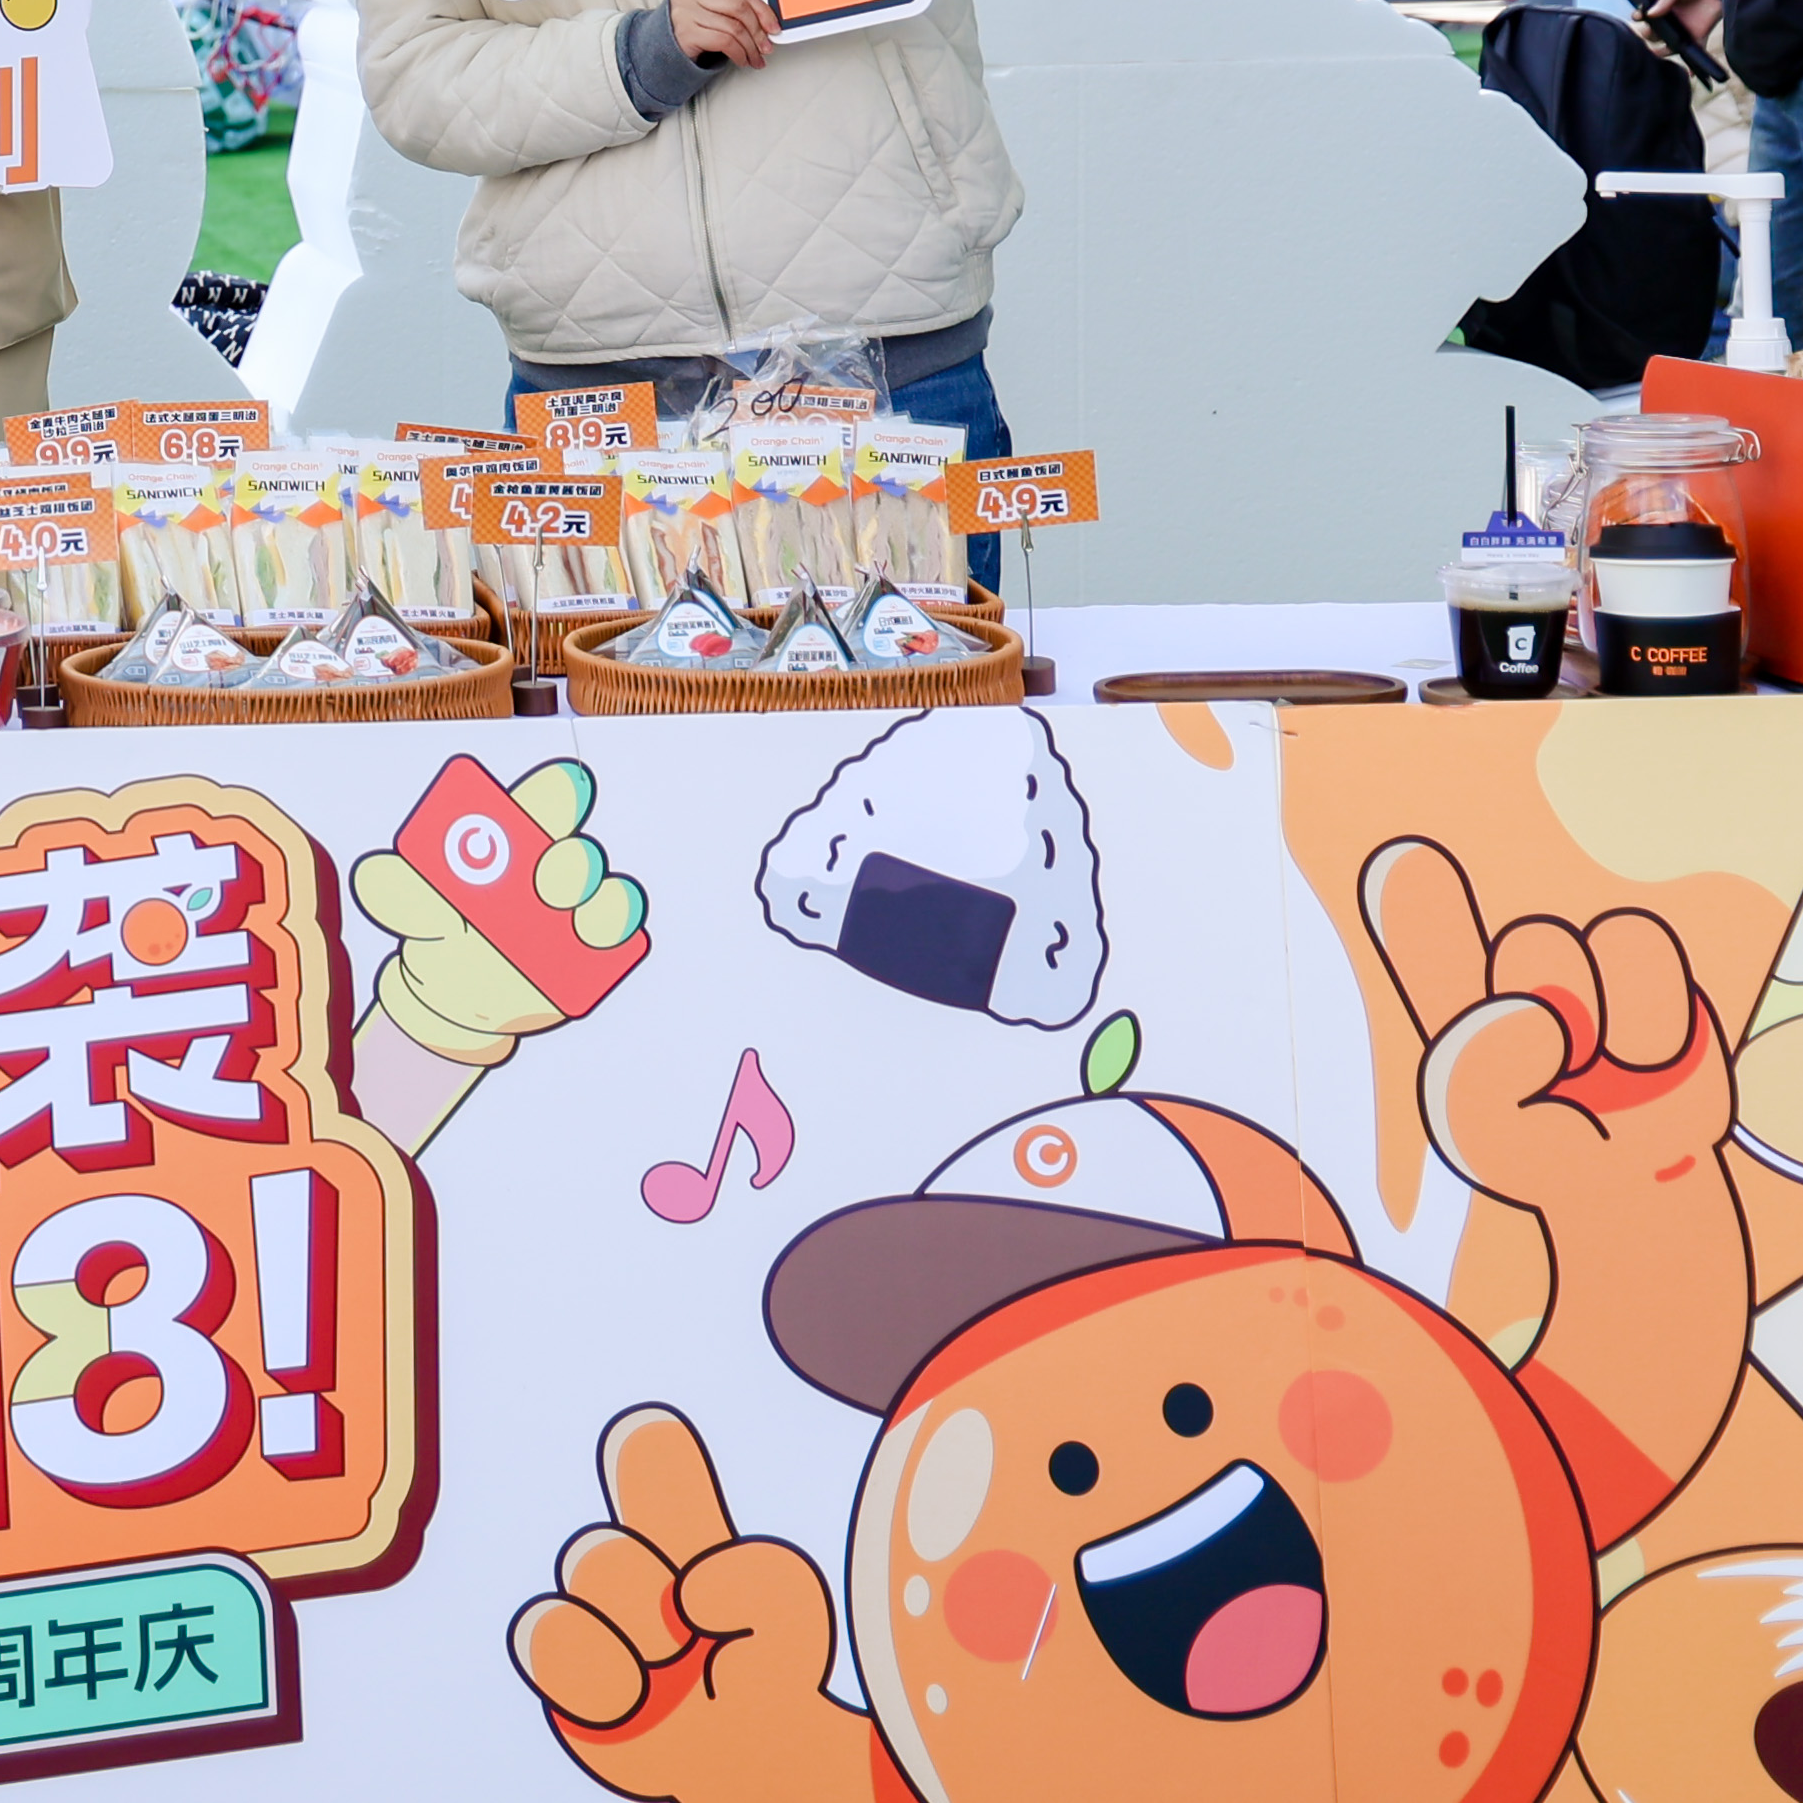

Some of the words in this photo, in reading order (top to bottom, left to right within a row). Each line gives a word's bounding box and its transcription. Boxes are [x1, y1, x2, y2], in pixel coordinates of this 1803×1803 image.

[751, 437, 789, 447] Orange
[874, 433, 911, 445] Orange
[748, 454, 827, 467] SANDWICH
[869, 451, 948, 466] SANDWICH
[252, 461, 287, 472] Orange
[127, 472, 163, 483] Orange
[637, 473, 715, 485] SANDWICH
[247, 479, 326, 493] SANDWICH
[126, 487, 204, 500] SANDWICH
[978, 483, 1067, 523] 4.9元
[500, 501, 592, 538] 4.2元
[1630, 645, 1642, 662] C
[1647, 646, 1708, 664] COFFEE
[1499, 662, 1540, 675] Coffee
